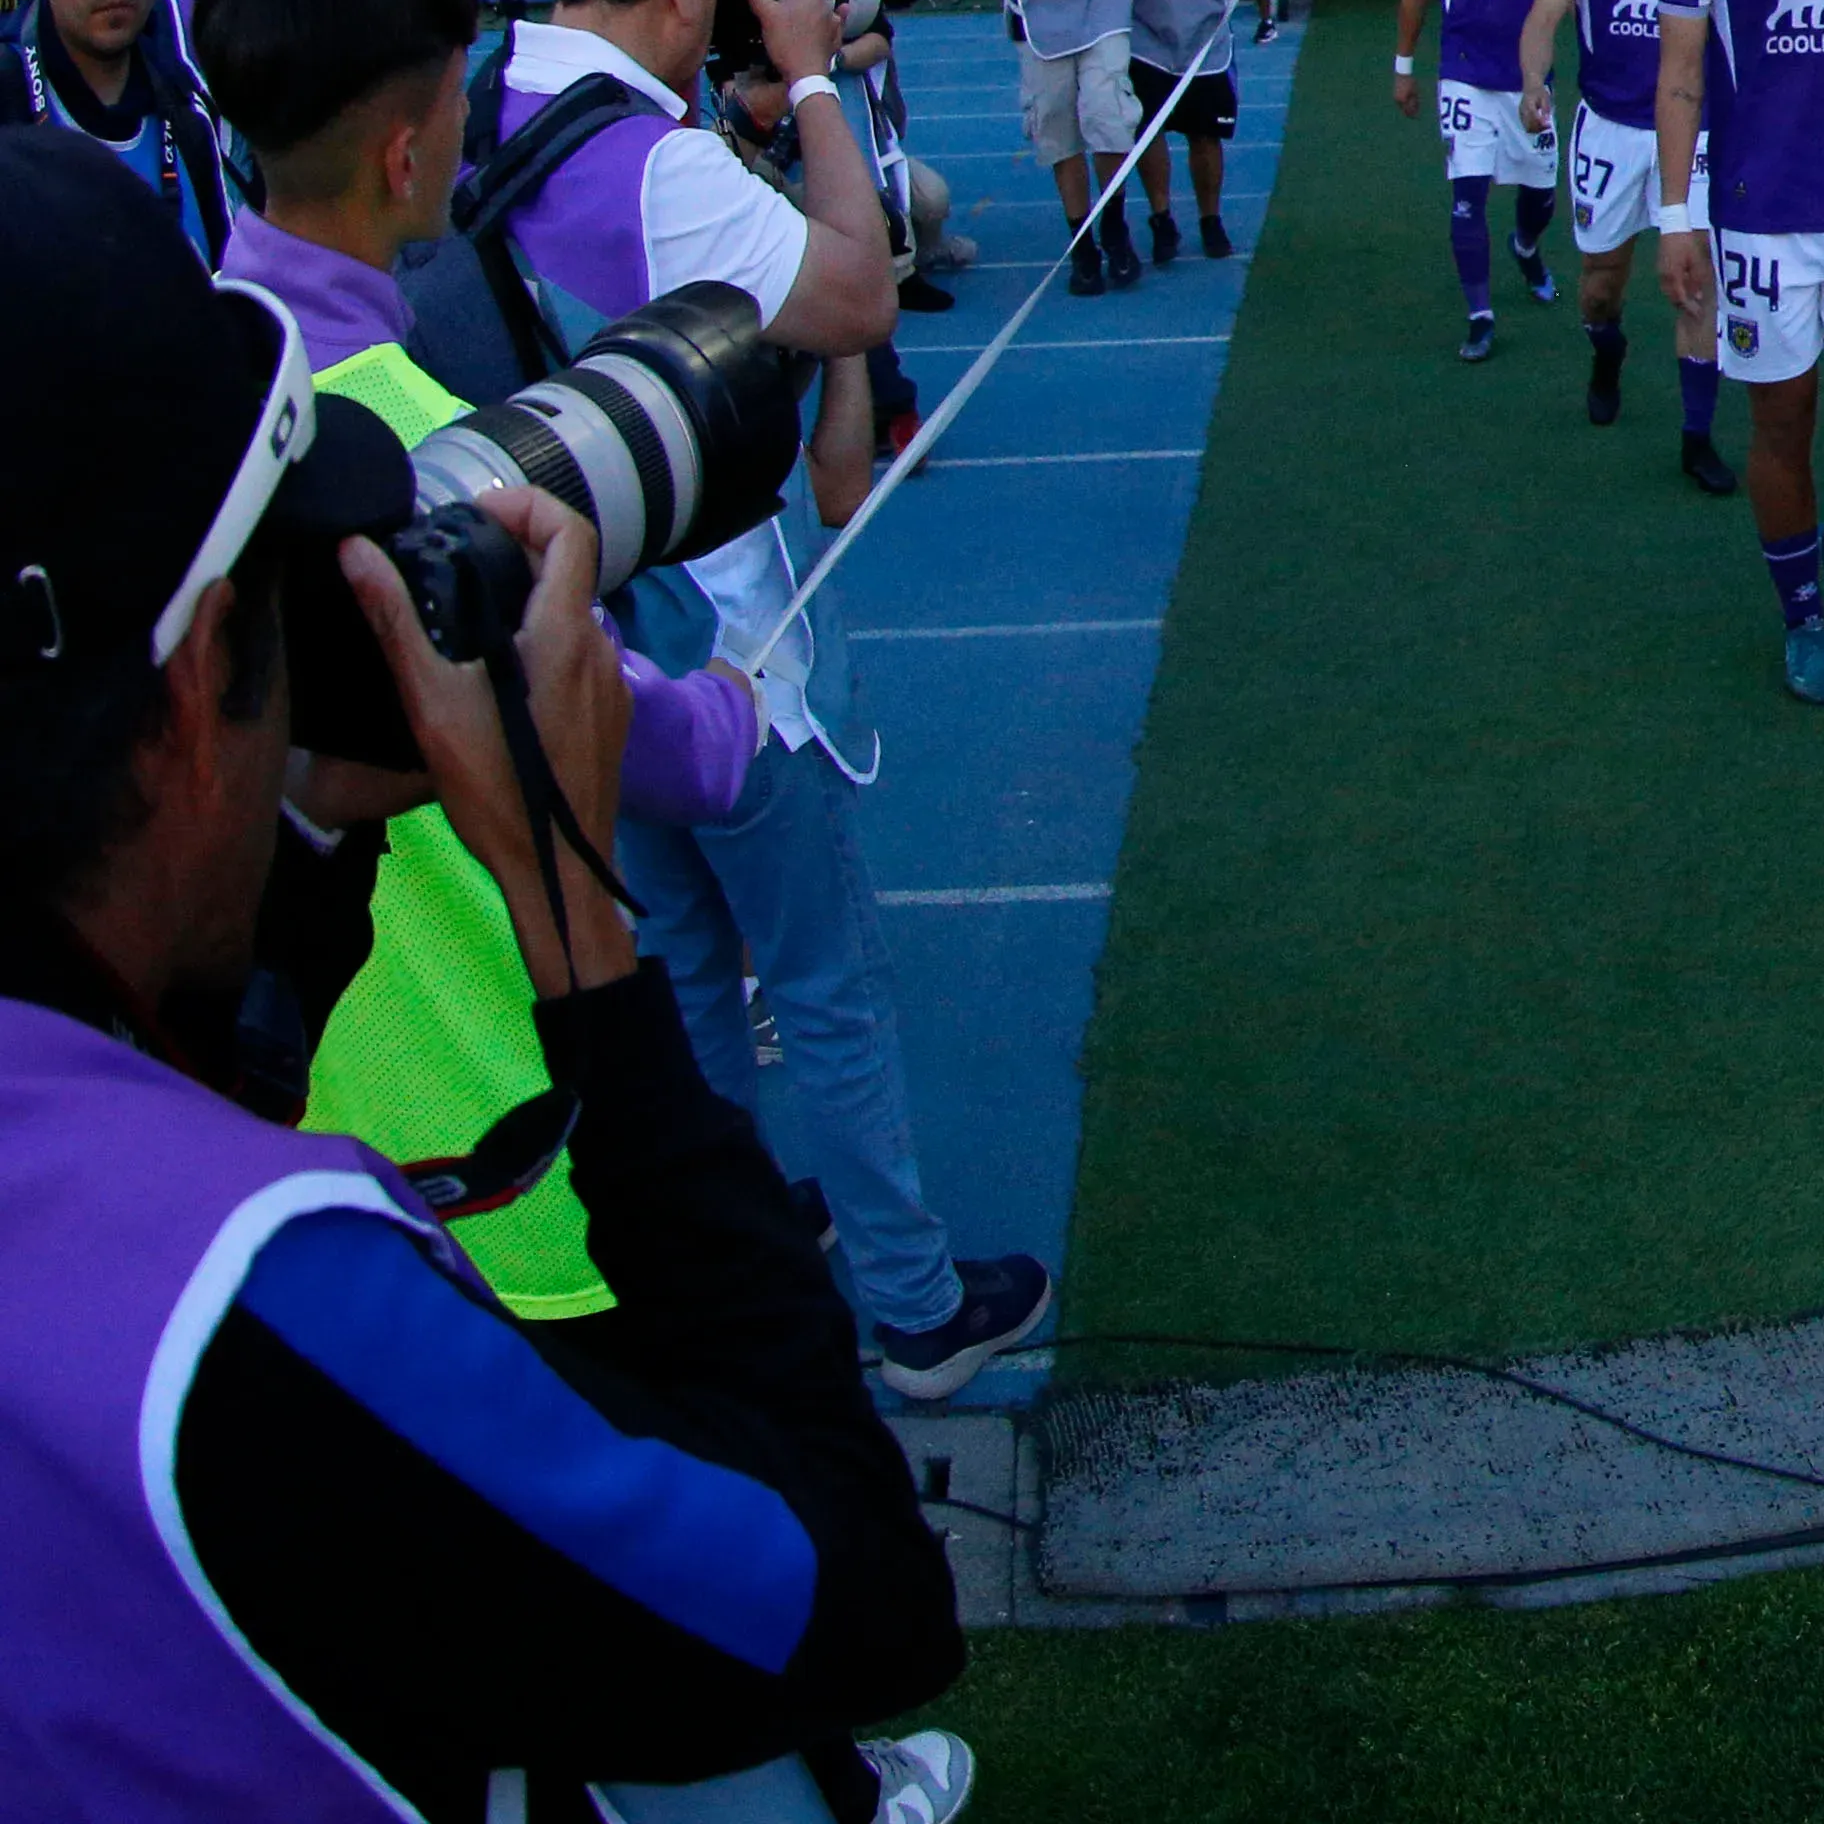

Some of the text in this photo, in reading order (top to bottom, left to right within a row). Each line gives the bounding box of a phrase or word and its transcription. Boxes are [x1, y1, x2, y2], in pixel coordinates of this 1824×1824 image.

[1440, 96, 1472, 132] 26
[1576, 153, 1614, 198] 27
[1724, 250, 1780, 313] 24
